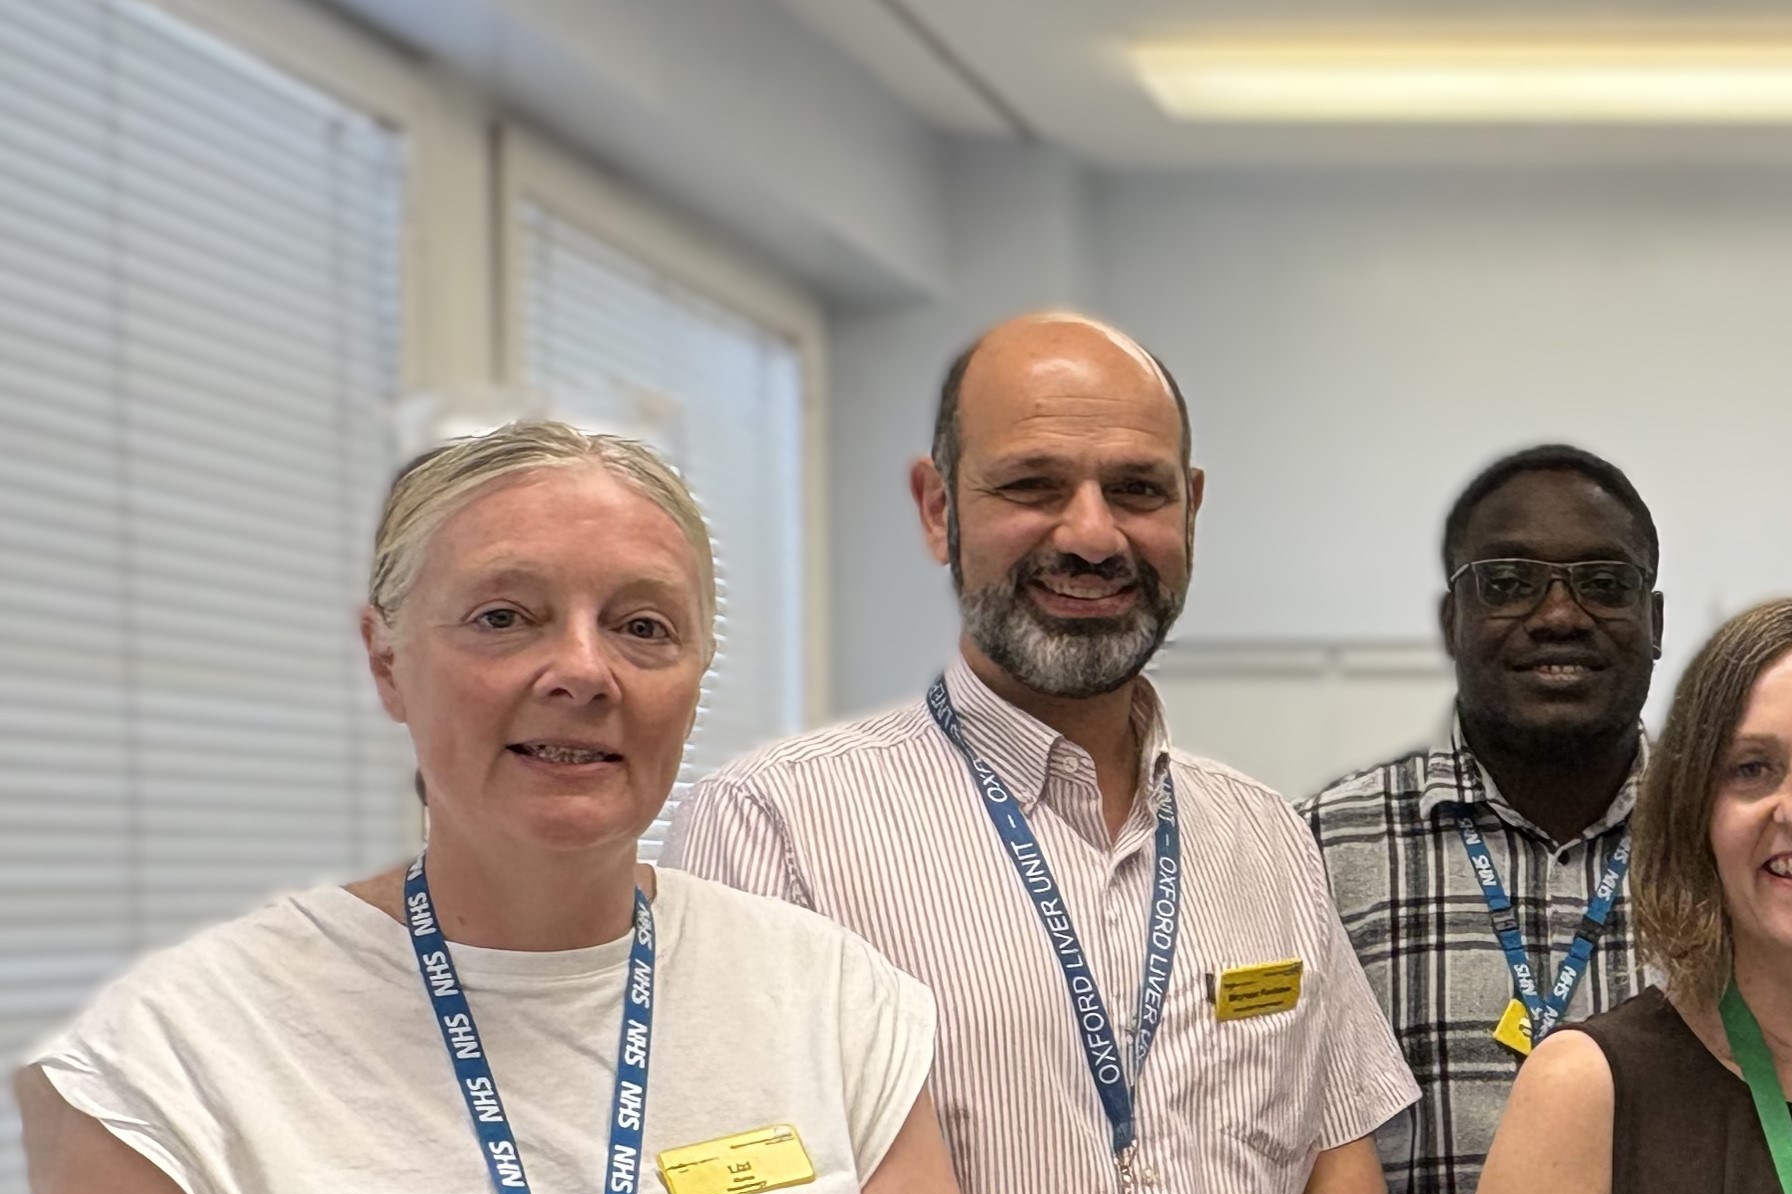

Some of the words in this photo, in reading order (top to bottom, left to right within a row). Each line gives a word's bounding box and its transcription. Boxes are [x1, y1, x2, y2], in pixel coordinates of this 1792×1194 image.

[1010, 841, 1052, 893] UNIT
[1472, 854, 1497, 886] NHS
[1596, 868, 1620, 901] NHS
[406, 890, 438, 937] NHS
[1152, 856, 1178, 950] OXFORD
[1041, 897, 1084, 969] LIVER
[422, 949, 460, 998] NHS
[630, 957, 653, 1010] NHS
[1142, 953, 1168, 1025] LIVER
[1554, 965, 1577, 1000] NHS
[443, 1012, 482, 1061] NHS
[623, 1018, 650, 1070] NHS
[1073, 976, 1121, 1084] OXFORD
[465, 1075, 505, 1123] NHS
[617, 1080, 643, 1132] NHS
[488, 1139, 527, 1188] NHS
[610, 1144, 636, 1194] NHS
